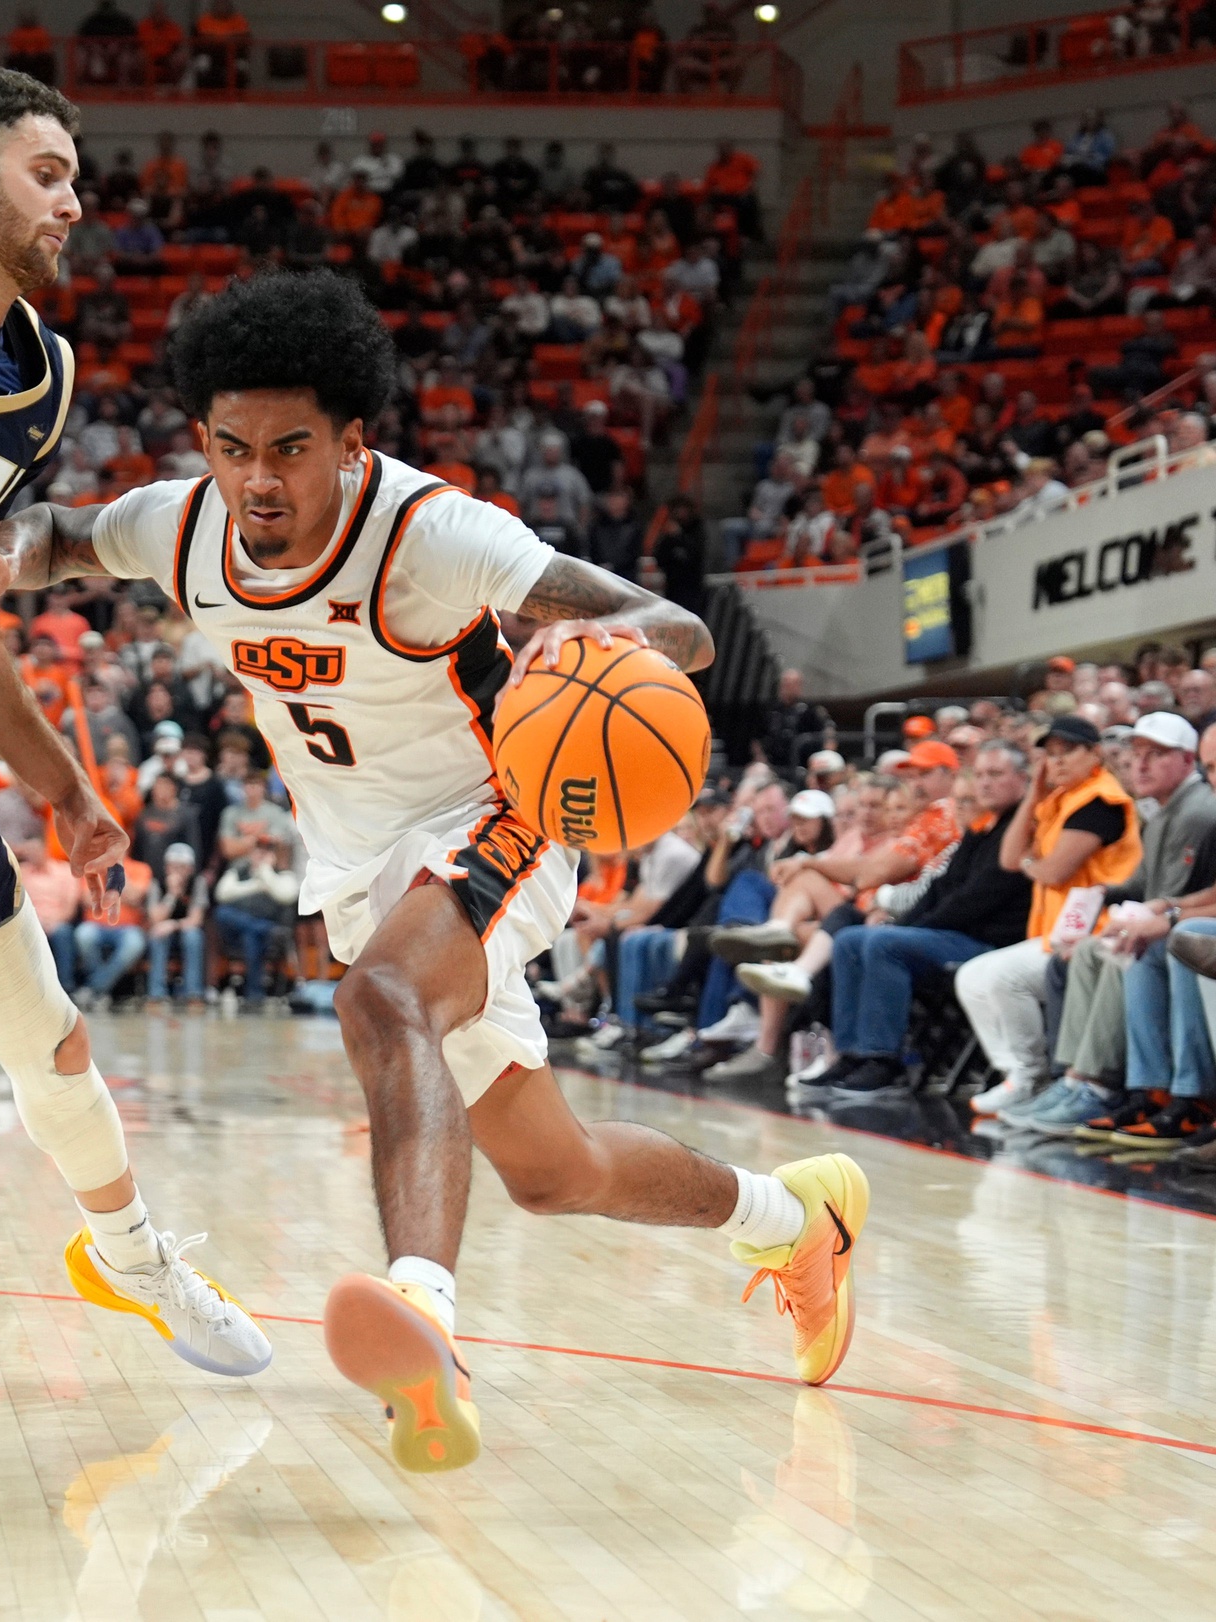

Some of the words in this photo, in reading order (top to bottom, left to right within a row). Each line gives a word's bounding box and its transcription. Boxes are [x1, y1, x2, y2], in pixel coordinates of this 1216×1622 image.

[1031, 512, 1200, 611] WELCOME
[232, 636, 346, 693] OSU
[277, 700, 357, 767] 5
